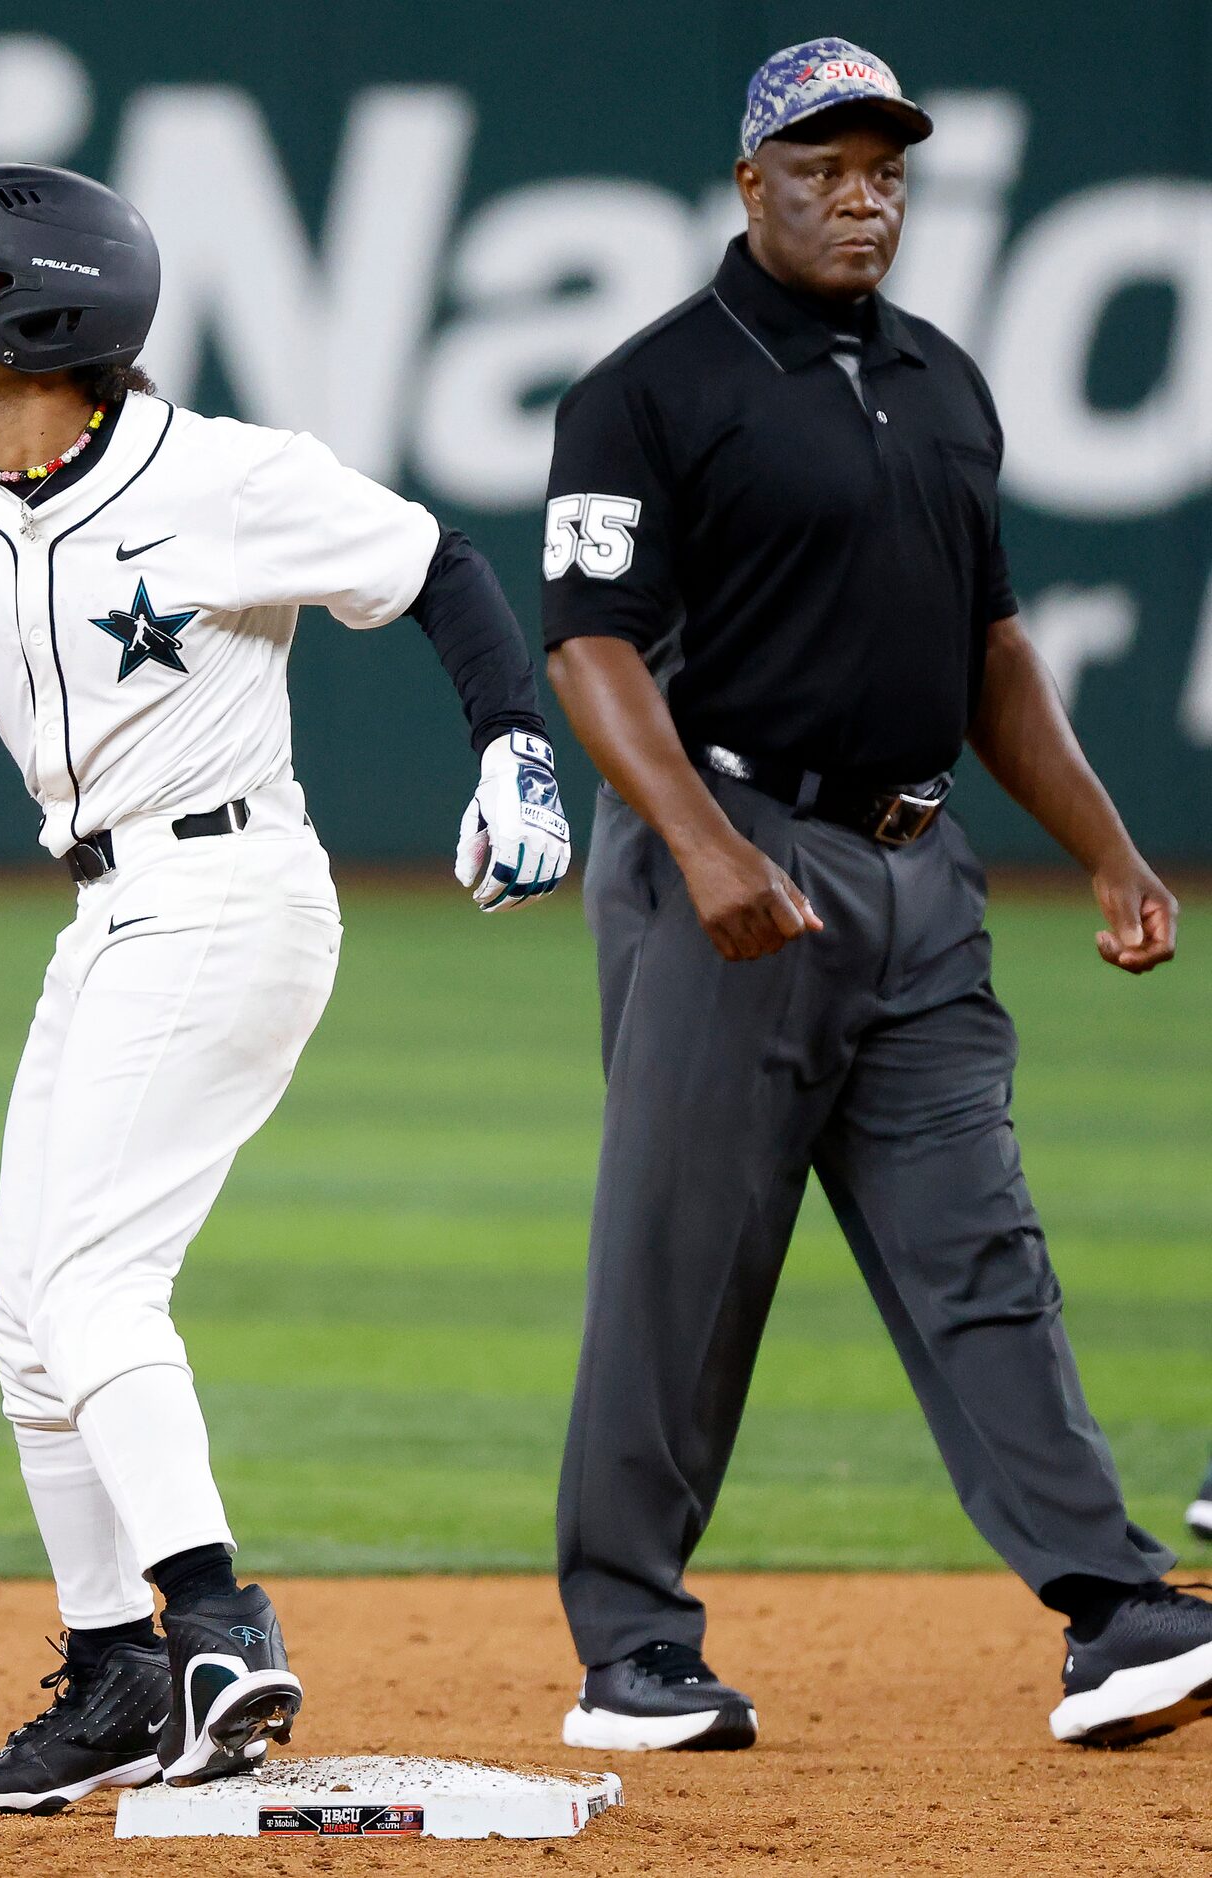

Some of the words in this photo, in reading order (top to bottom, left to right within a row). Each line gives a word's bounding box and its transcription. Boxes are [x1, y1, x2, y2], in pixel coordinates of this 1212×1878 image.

[31, 256, 100, 277] RAWLINGS
[542, 493, 643, 582] 55
[321, 1808, 361, 1823] HBCU
[274, 1819, 300, 1828] Mobile
[323, 1823, 358, 1833] CLASSIC
[376, 1822, 400, 1830] YOUTH
